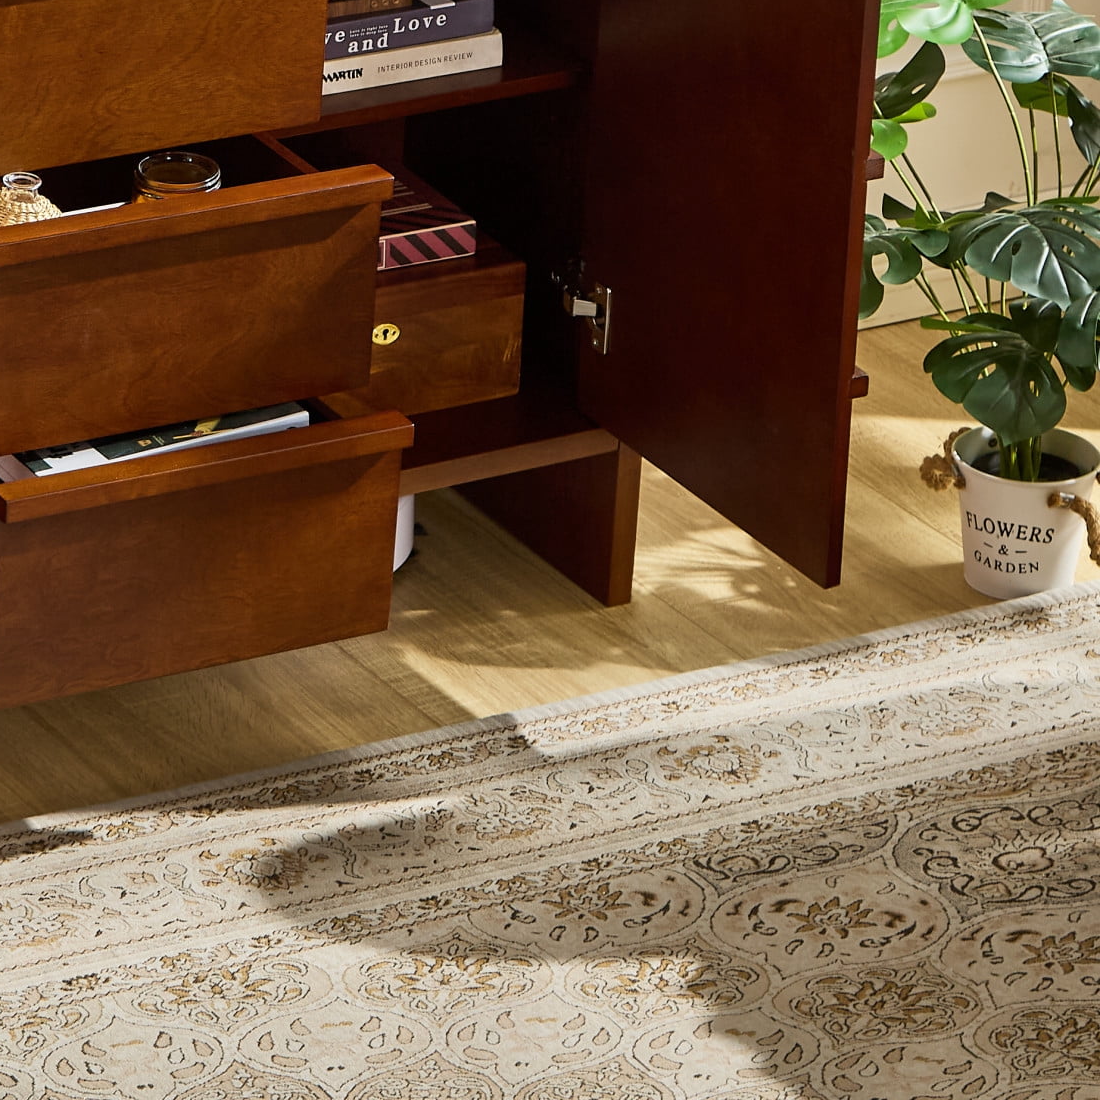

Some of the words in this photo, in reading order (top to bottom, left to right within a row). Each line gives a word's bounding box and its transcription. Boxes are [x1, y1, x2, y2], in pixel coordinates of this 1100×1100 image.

[324, 30, 346, 45] ve
[347, 33, 389, 53] and
[392, 14, 447, 34] Love
[377, 62, 412, 74] INTERIOR
[414, 57, 442, 68] DESIGN
[443, 51, 473, 62] REVIEW
[966, 511, 1055, 544] FLOWERS
[974, 550, 1039, 574] GARDEN
[998, 545, 1009, 556] &
